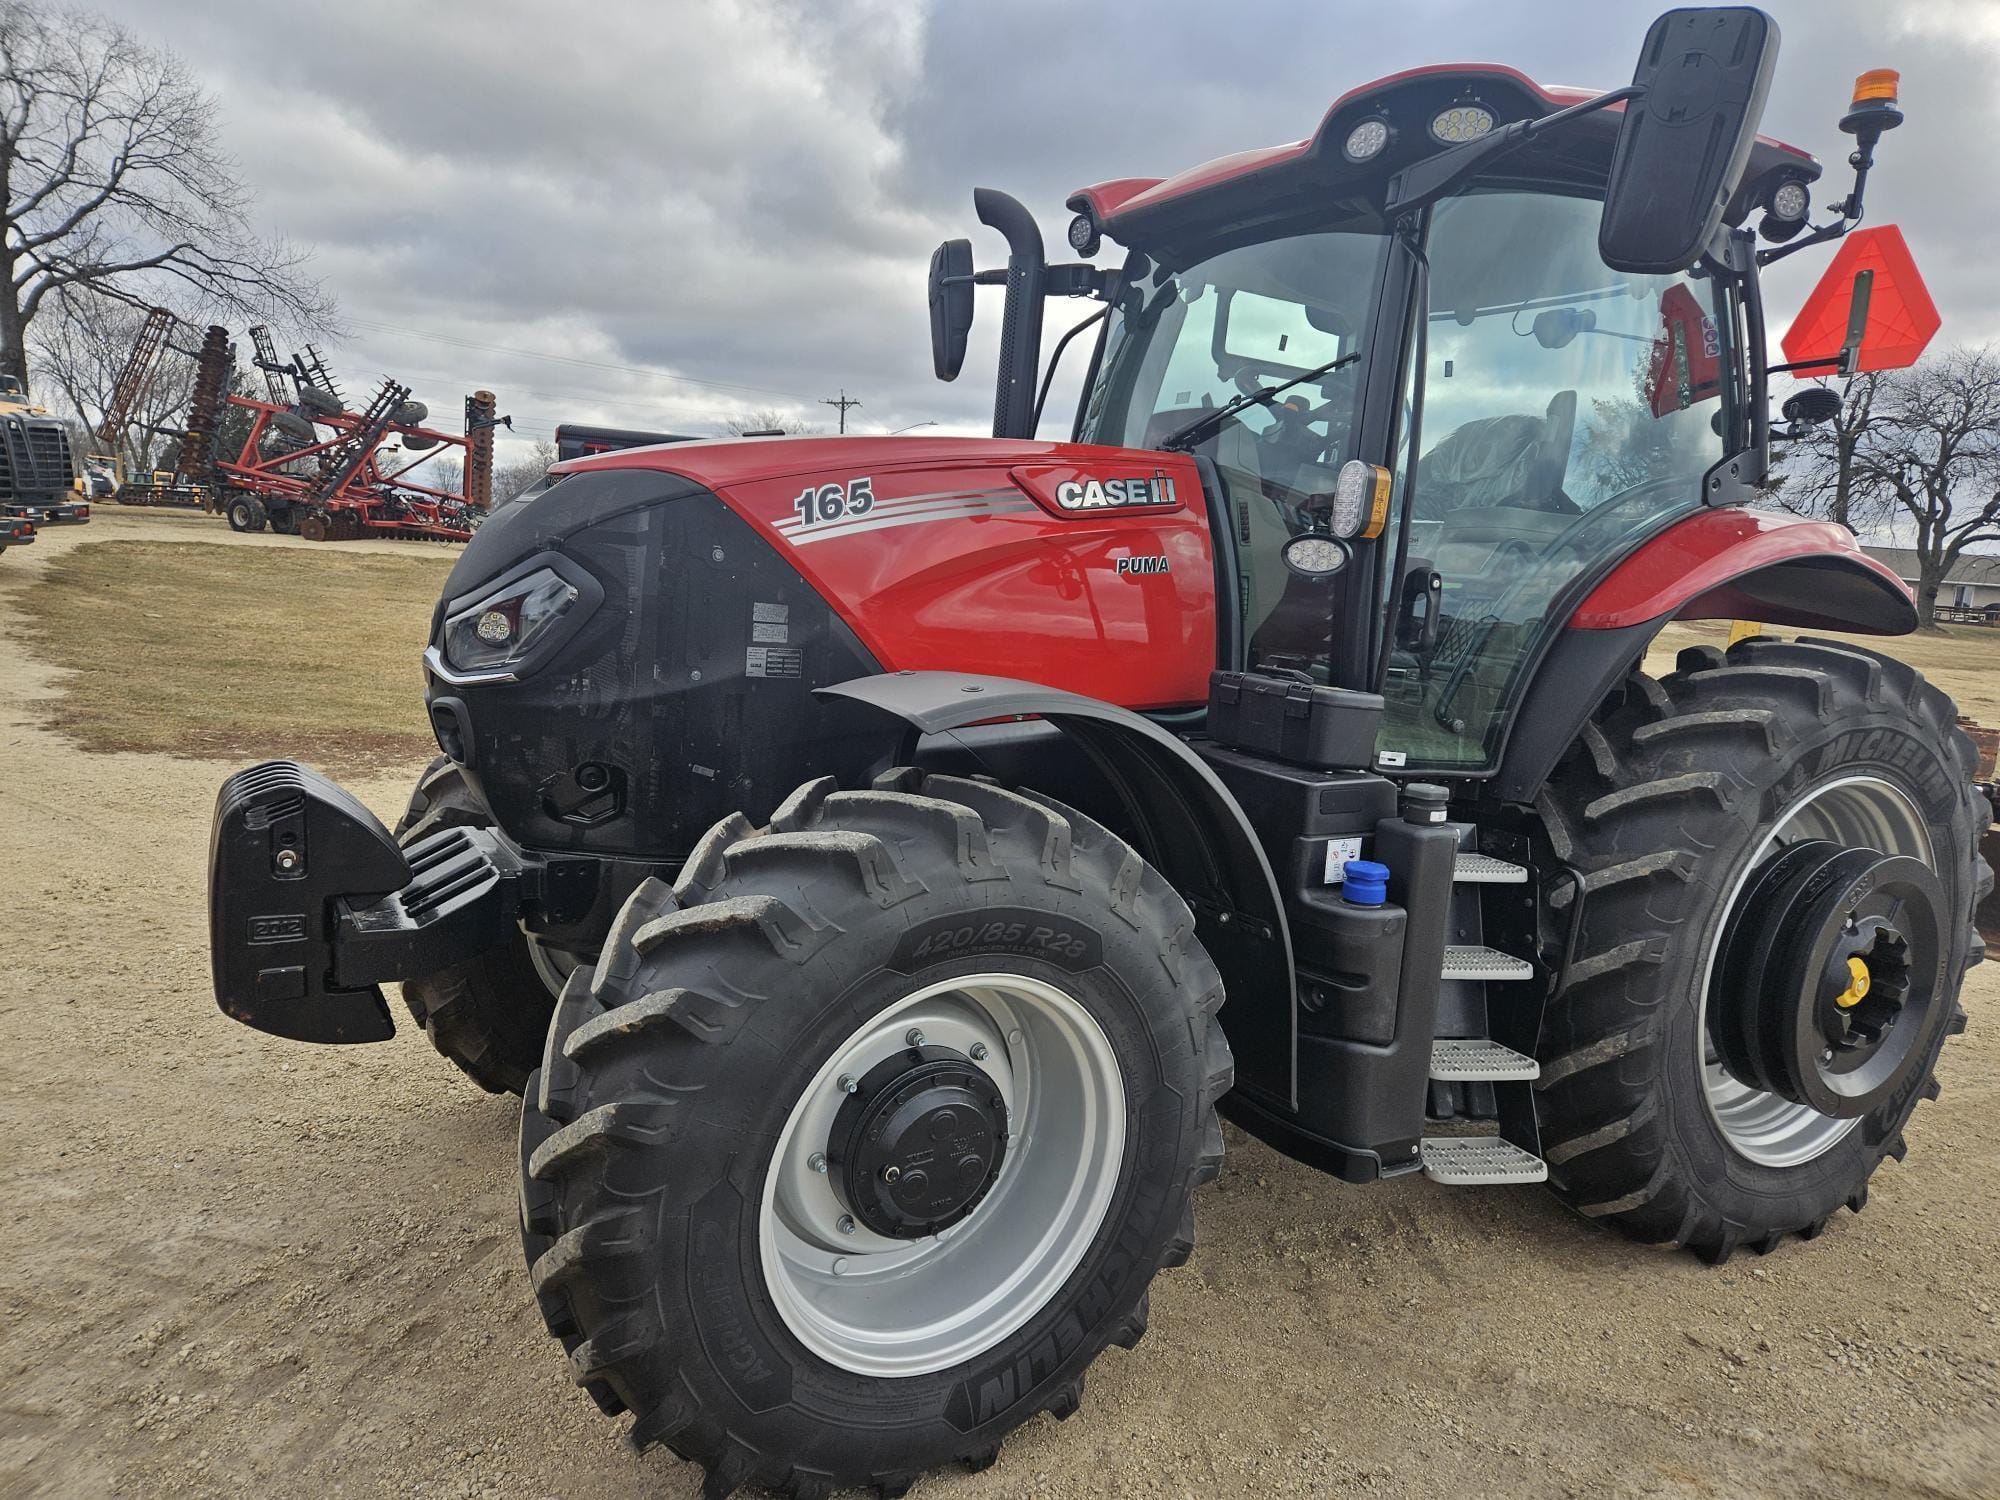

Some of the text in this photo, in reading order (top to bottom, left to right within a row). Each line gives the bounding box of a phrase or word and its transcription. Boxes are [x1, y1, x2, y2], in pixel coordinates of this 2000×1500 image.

[794, 478, 875, 528] 165
[1116, 556, 1169, 574] PUMA
[1815, 729, 1950, 801] MICHELIN
[913, 922, 1025, 958] 420/85
[978, 1177, 1166, 1422] MICHELIN
